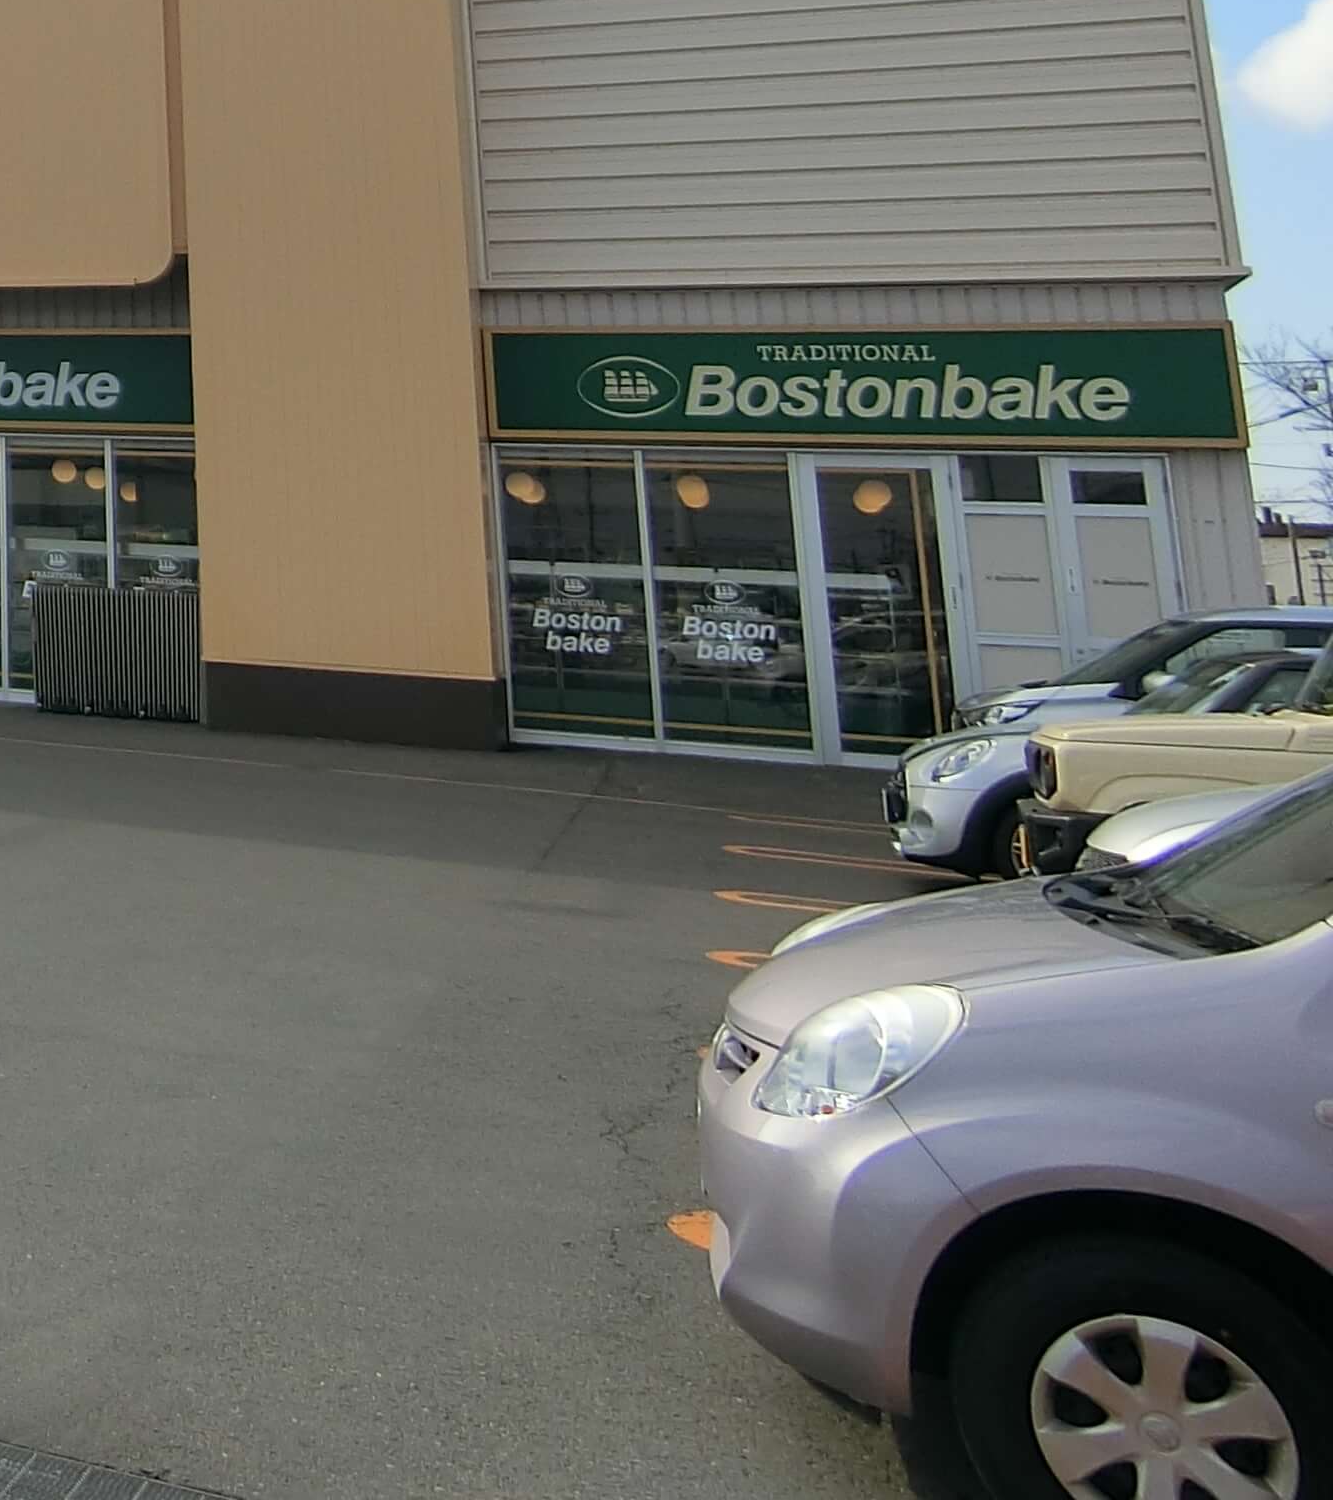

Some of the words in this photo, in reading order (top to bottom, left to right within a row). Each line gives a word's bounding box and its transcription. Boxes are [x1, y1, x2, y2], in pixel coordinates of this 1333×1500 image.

[756, 344, 936, 362] TRADITIONAL
[683, 363, 1131, 422] Bostonbake
[532, 608, 622, 633] Boston
[682, 616, 776, 641] Boston
[546, 630, 611, 655] bake
[696, 639, 765, 663] bake
